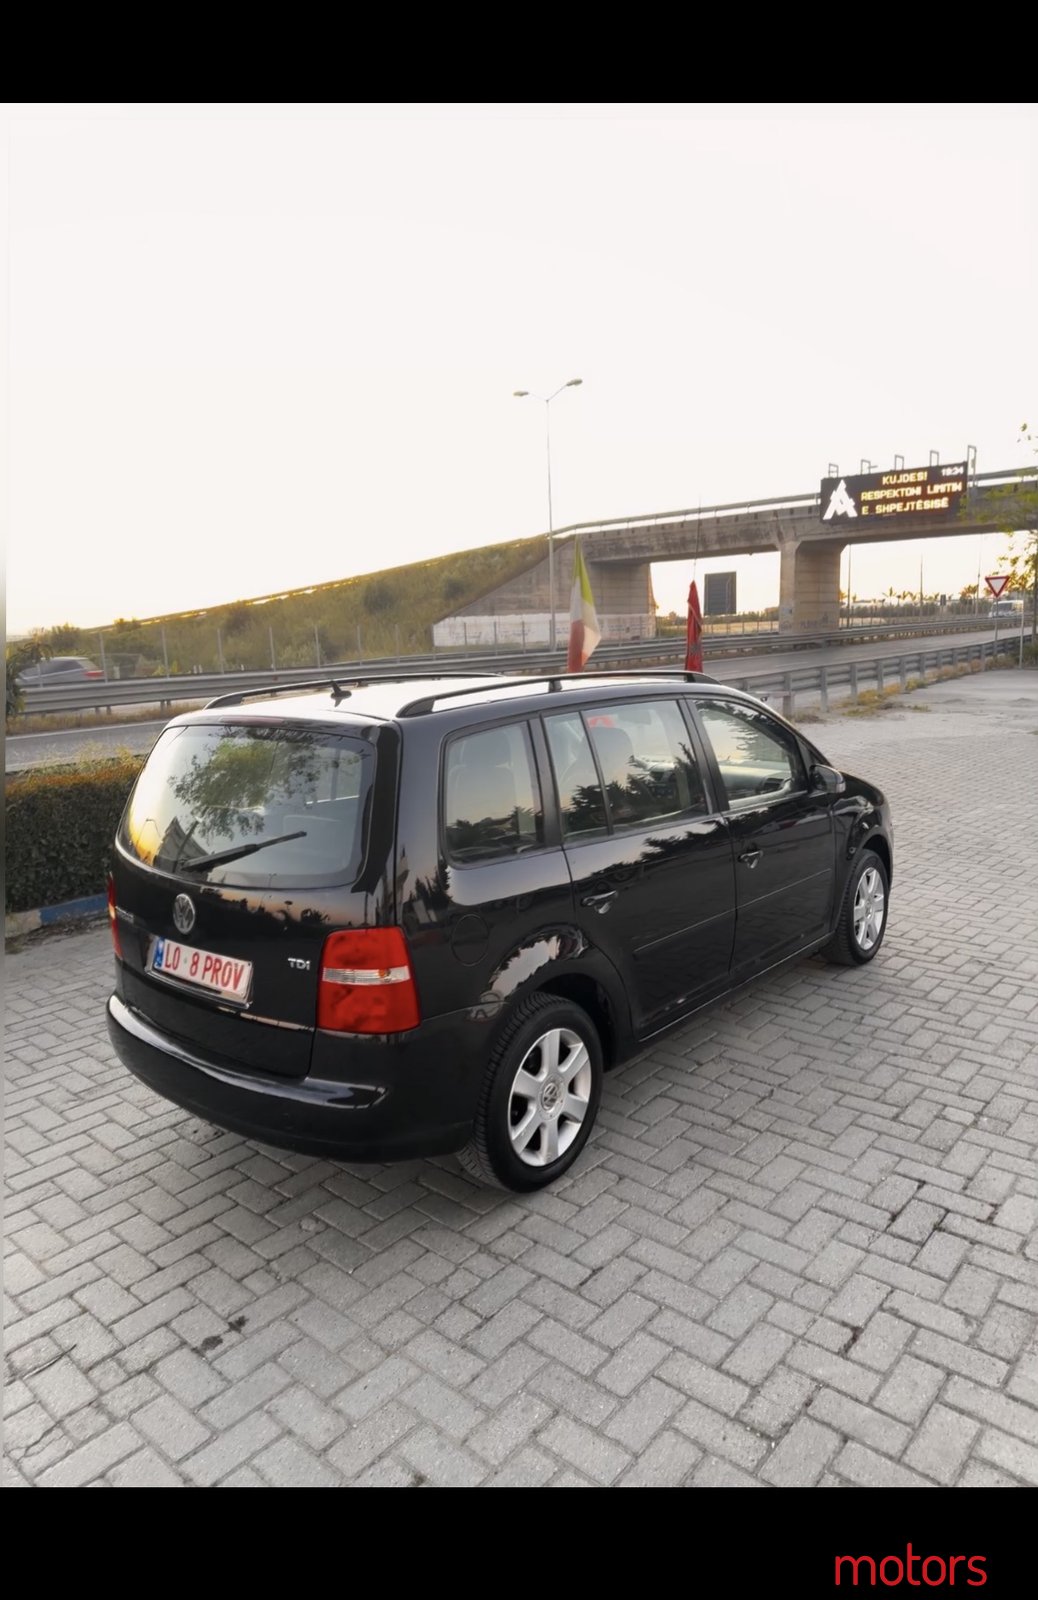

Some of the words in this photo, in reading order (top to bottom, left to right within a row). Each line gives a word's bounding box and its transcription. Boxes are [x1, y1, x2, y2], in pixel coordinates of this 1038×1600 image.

[861, 487, 922, 501] RESPEKTONI
[861, 506, 869, 515] E
[189, 951, 200, 977] 8
[201, 955, 244, 991] PROV
